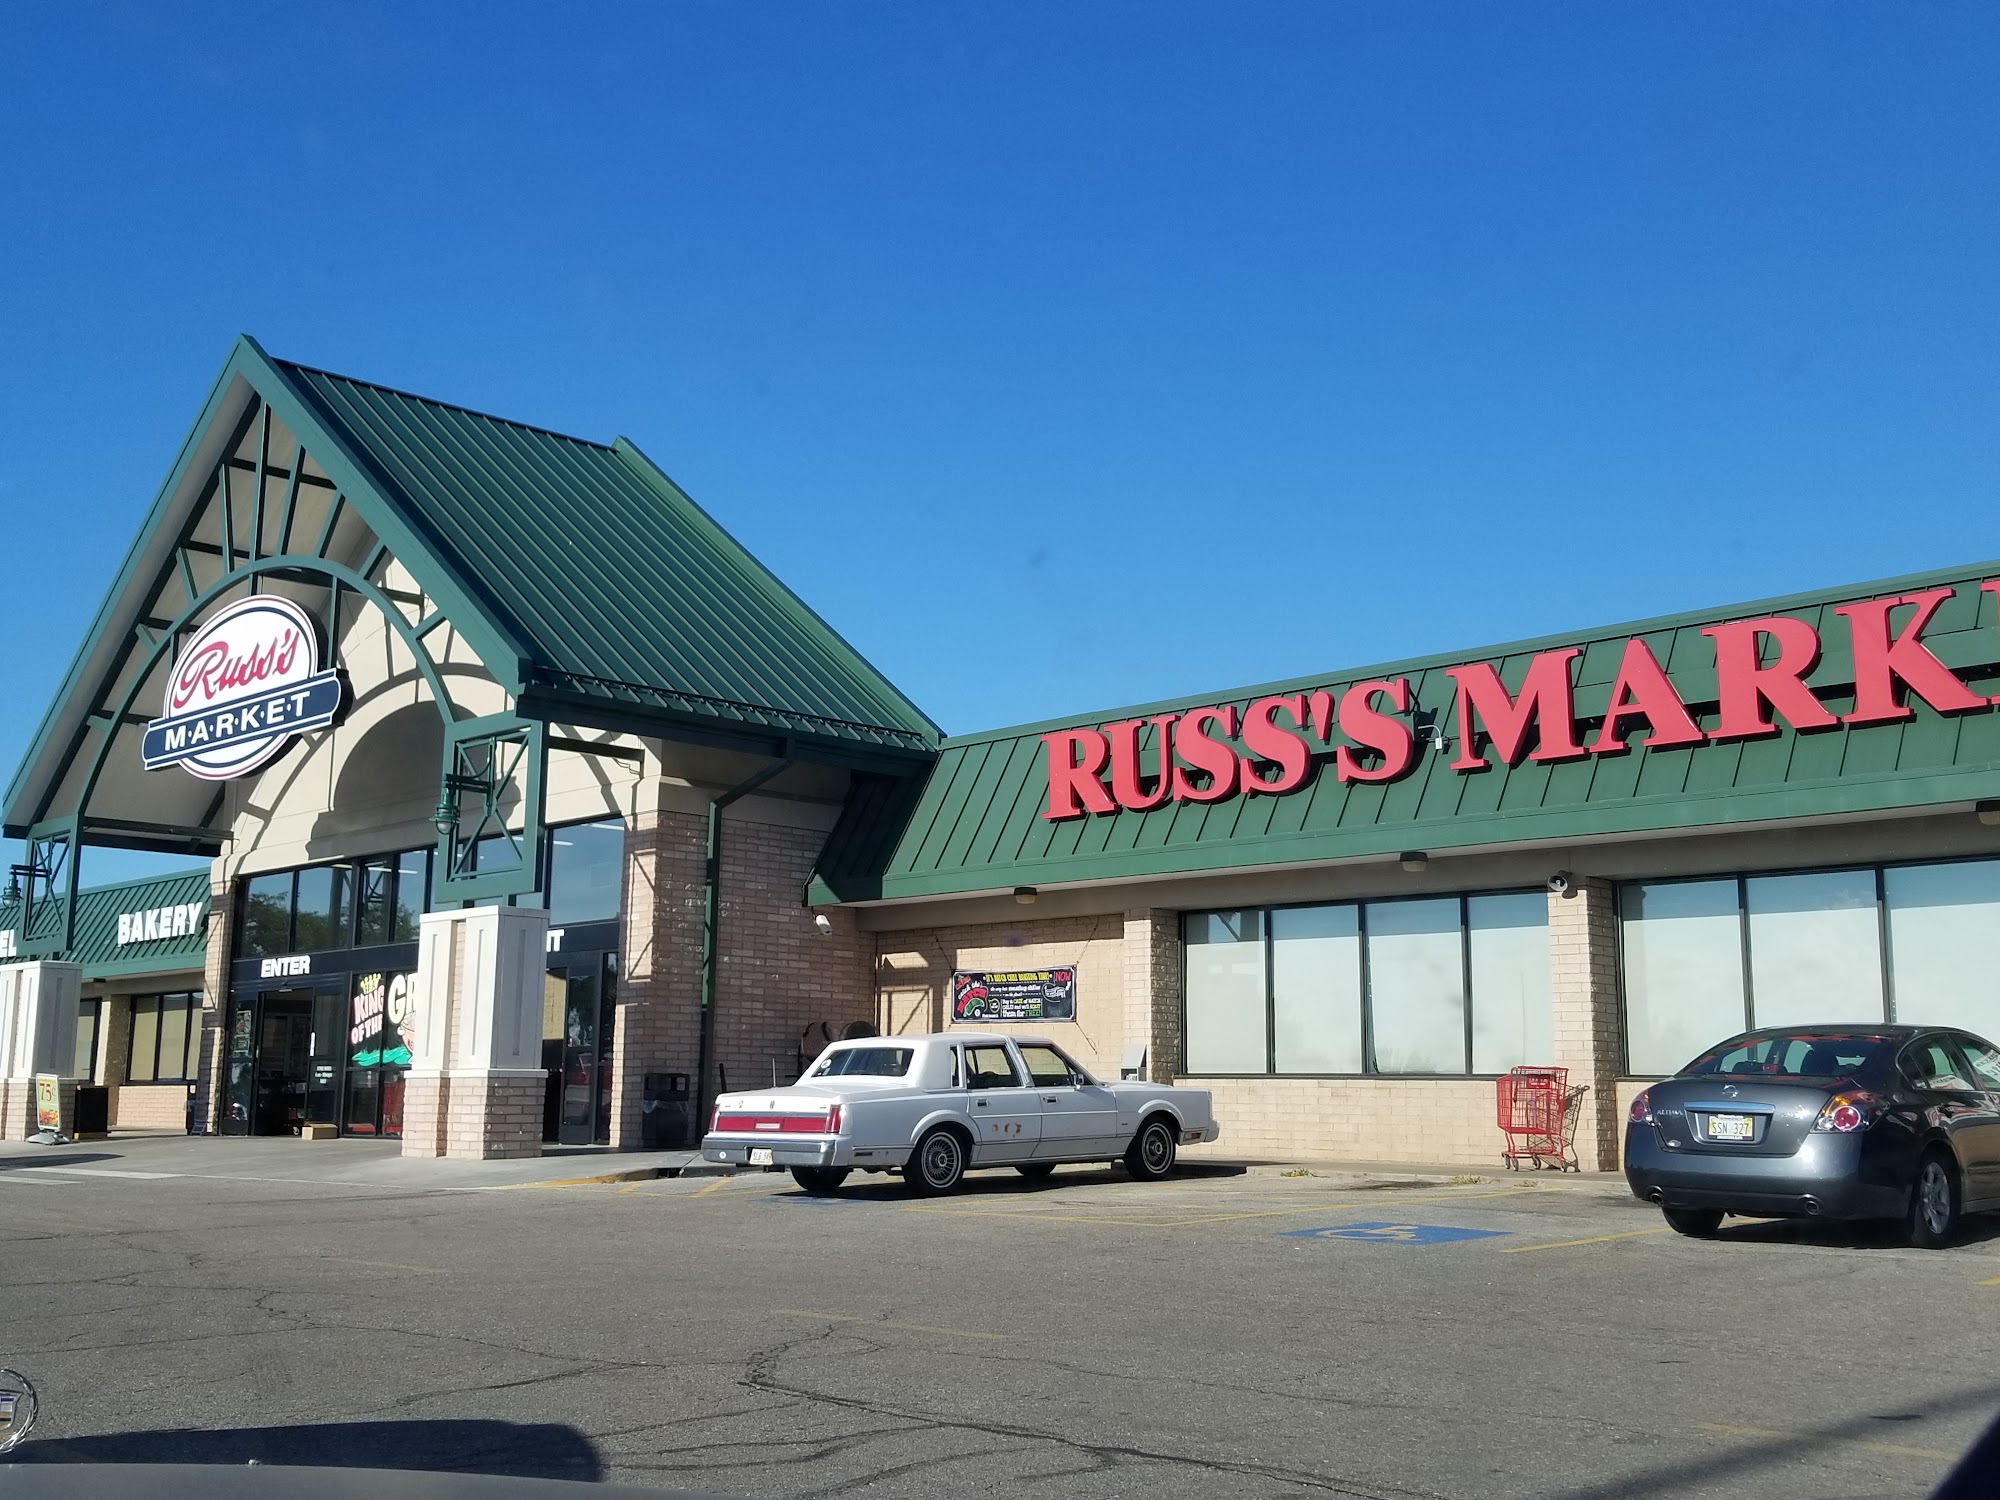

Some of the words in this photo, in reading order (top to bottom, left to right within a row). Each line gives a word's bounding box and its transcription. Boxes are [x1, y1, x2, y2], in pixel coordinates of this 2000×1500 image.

[172, 628, 300, 709] Russ's
[1041, 679, 1414, 821] RUSS'S
[1444, 579, 2000, 772] MARK
[118, 902, 203, 945] BAKERY
[261, 955, 310, 978] ENTER
[353, 985, 385, 1025] KING
[1734, 1122, 1749, 1135] 327
